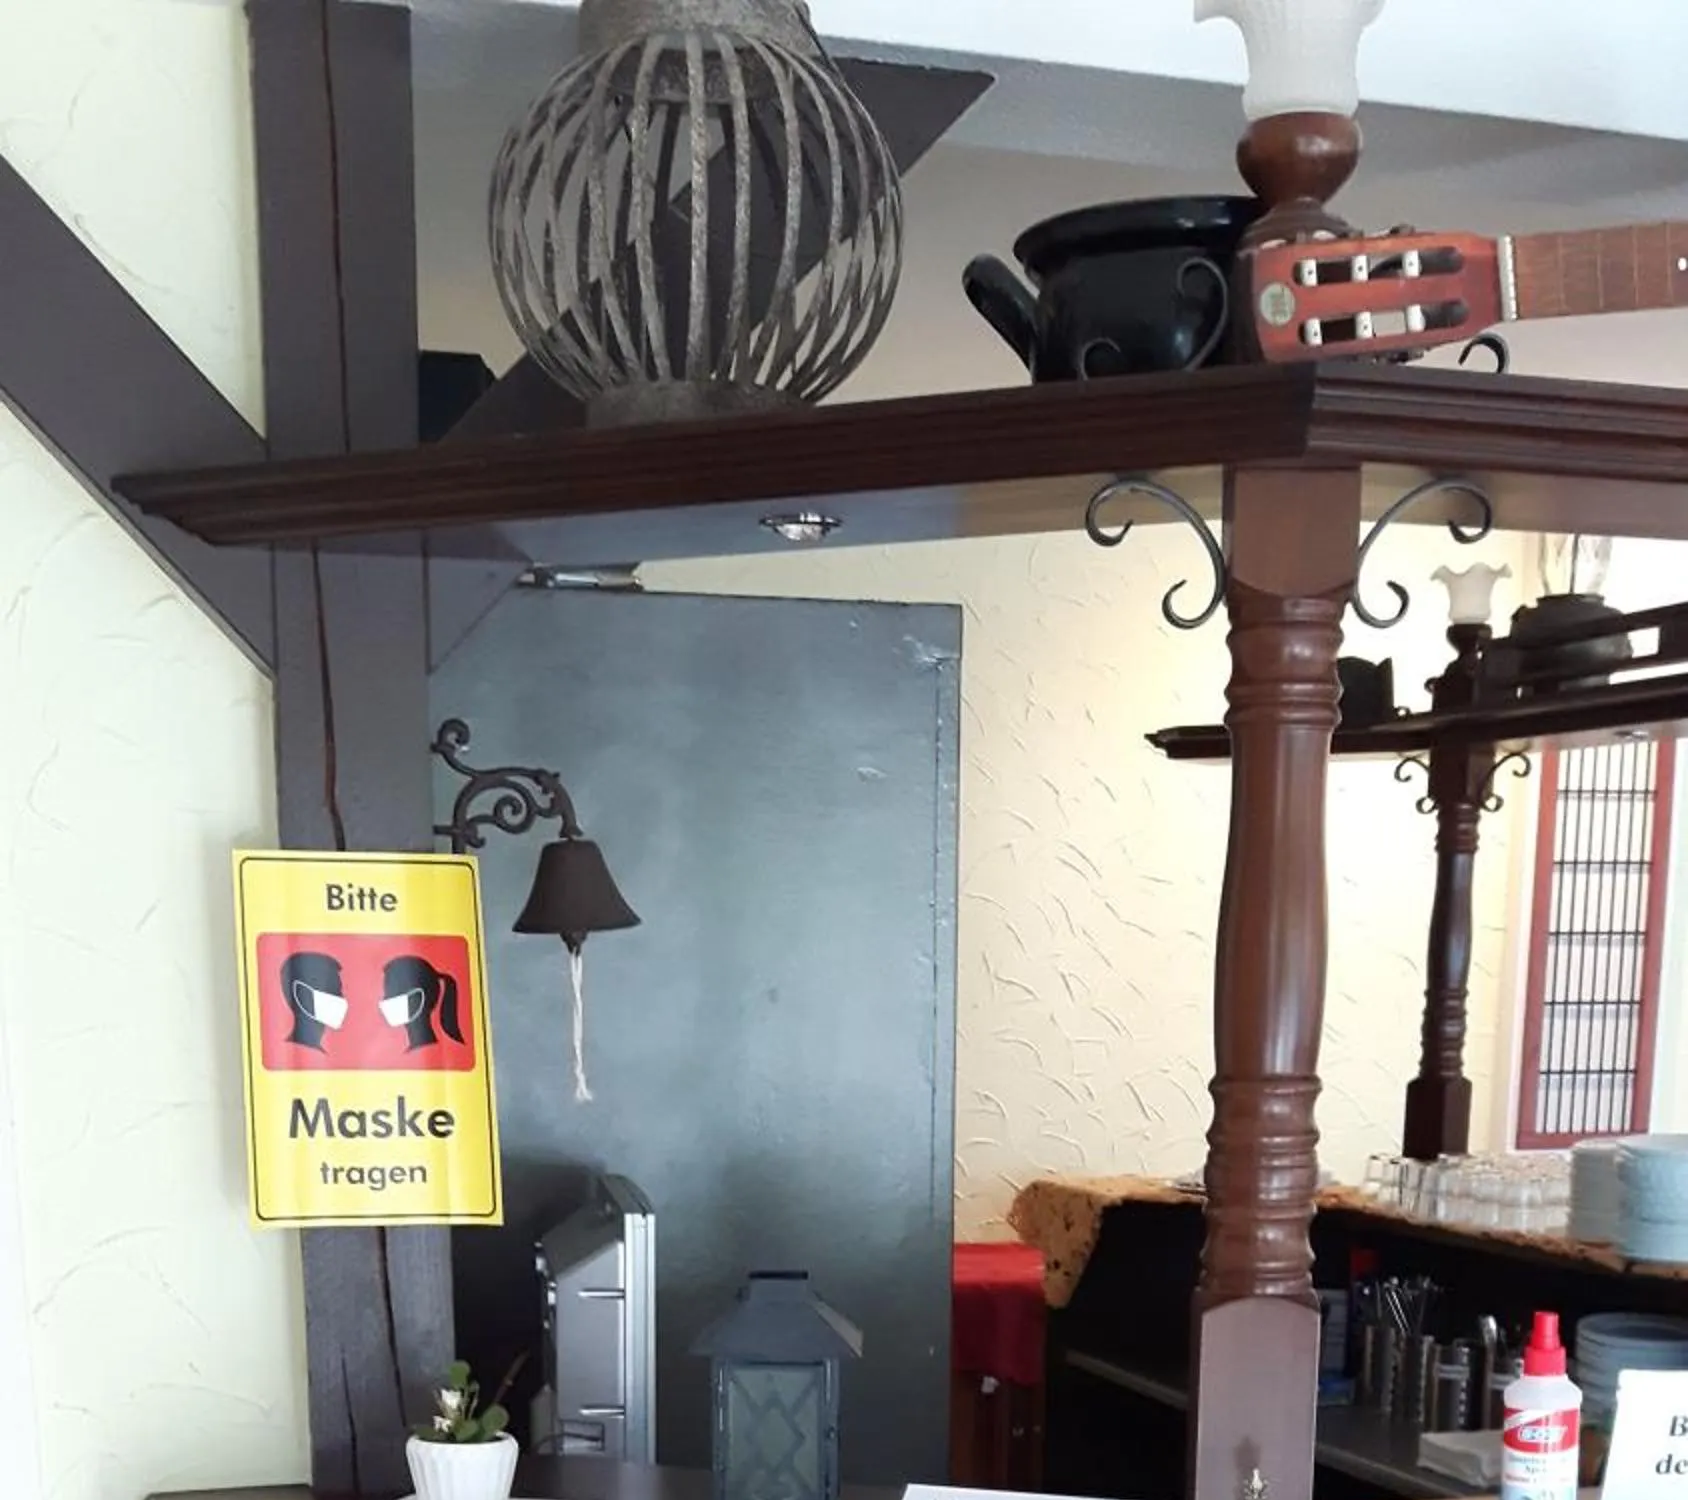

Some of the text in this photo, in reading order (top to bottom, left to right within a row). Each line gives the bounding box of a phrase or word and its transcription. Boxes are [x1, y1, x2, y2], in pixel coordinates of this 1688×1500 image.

[326, 883, 399, 912] Bitte
[289, 1095, 456, 1140] Maske
[320, 1160, 428, 1191] tragen
